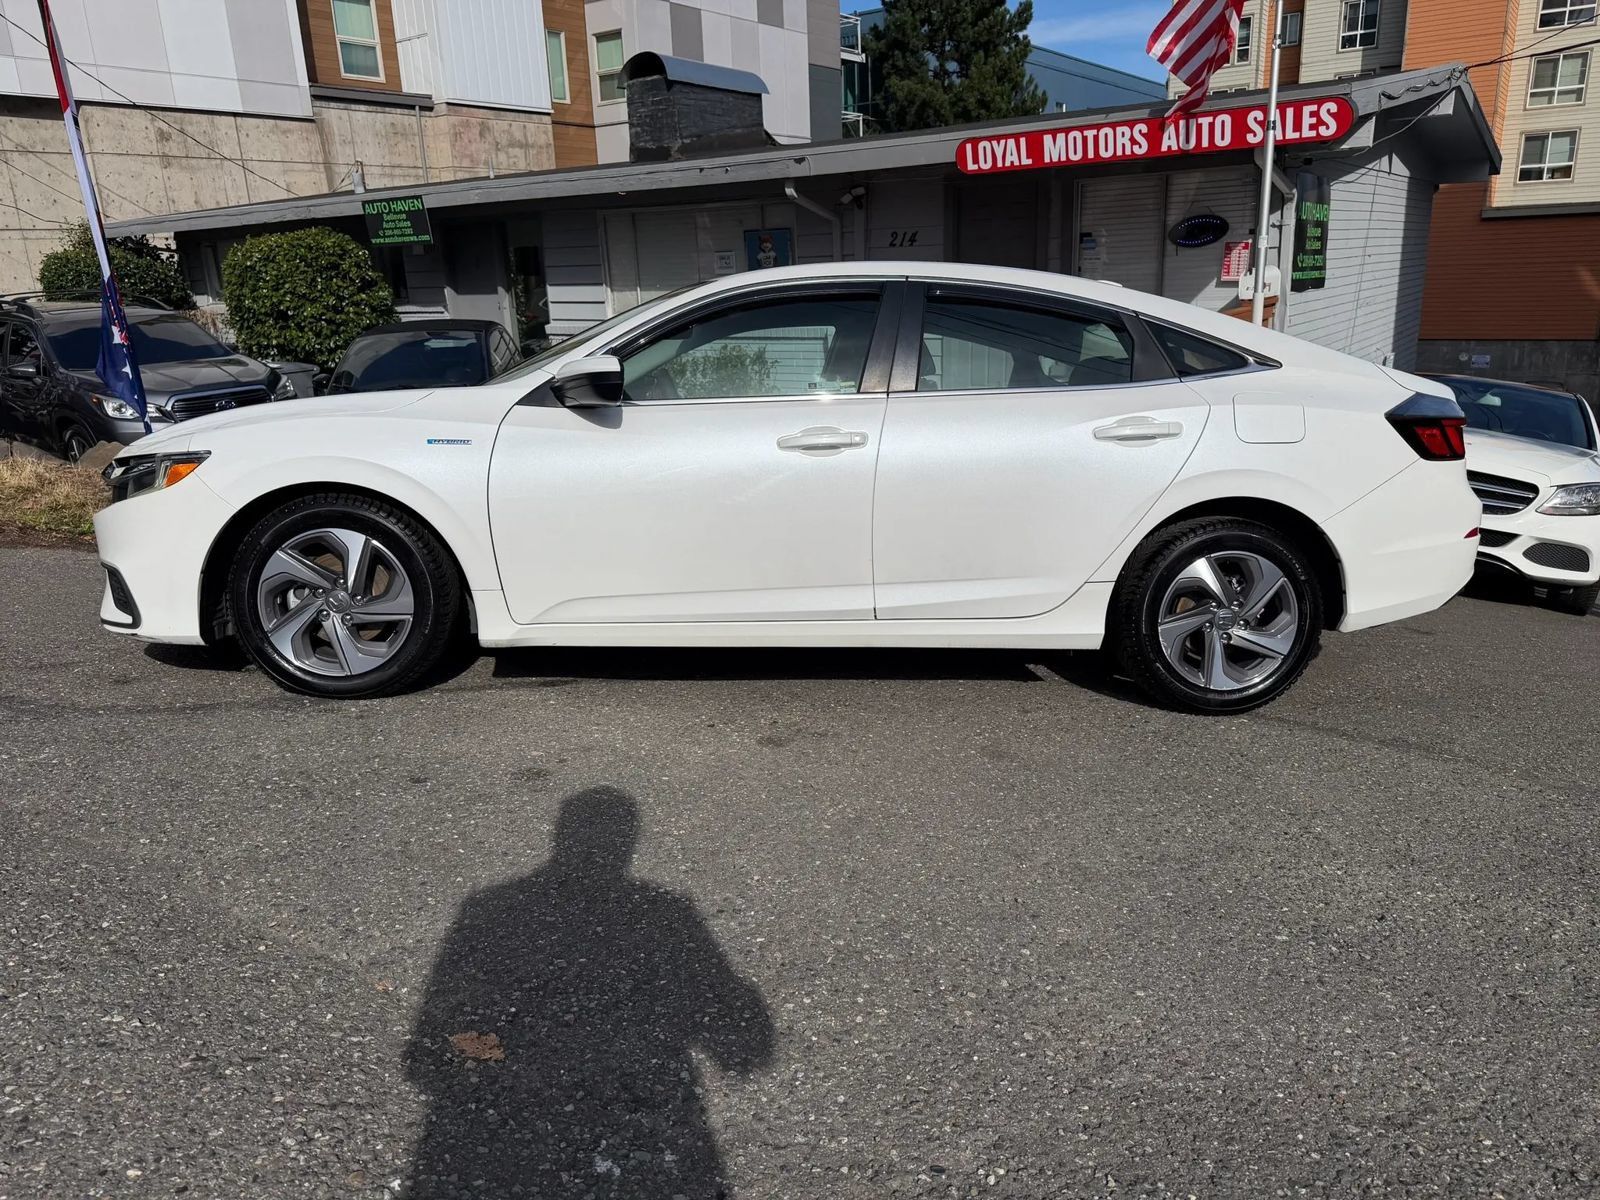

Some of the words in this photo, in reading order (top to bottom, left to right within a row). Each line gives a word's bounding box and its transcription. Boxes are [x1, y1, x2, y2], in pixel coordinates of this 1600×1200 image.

[965, 136, 1033, 171] LOYAL
[1043, 123, 1149, 163] MOTORS
[1161, 113, 1232, 152] AUTO
[365, 202, 389, 214] AUTO
[390, 199, 423, 212] HAVEN
[383, 221, 395, 229] Auto
[395, 220, 411, 228] Sales
[889, 230, 919, 248] 214
